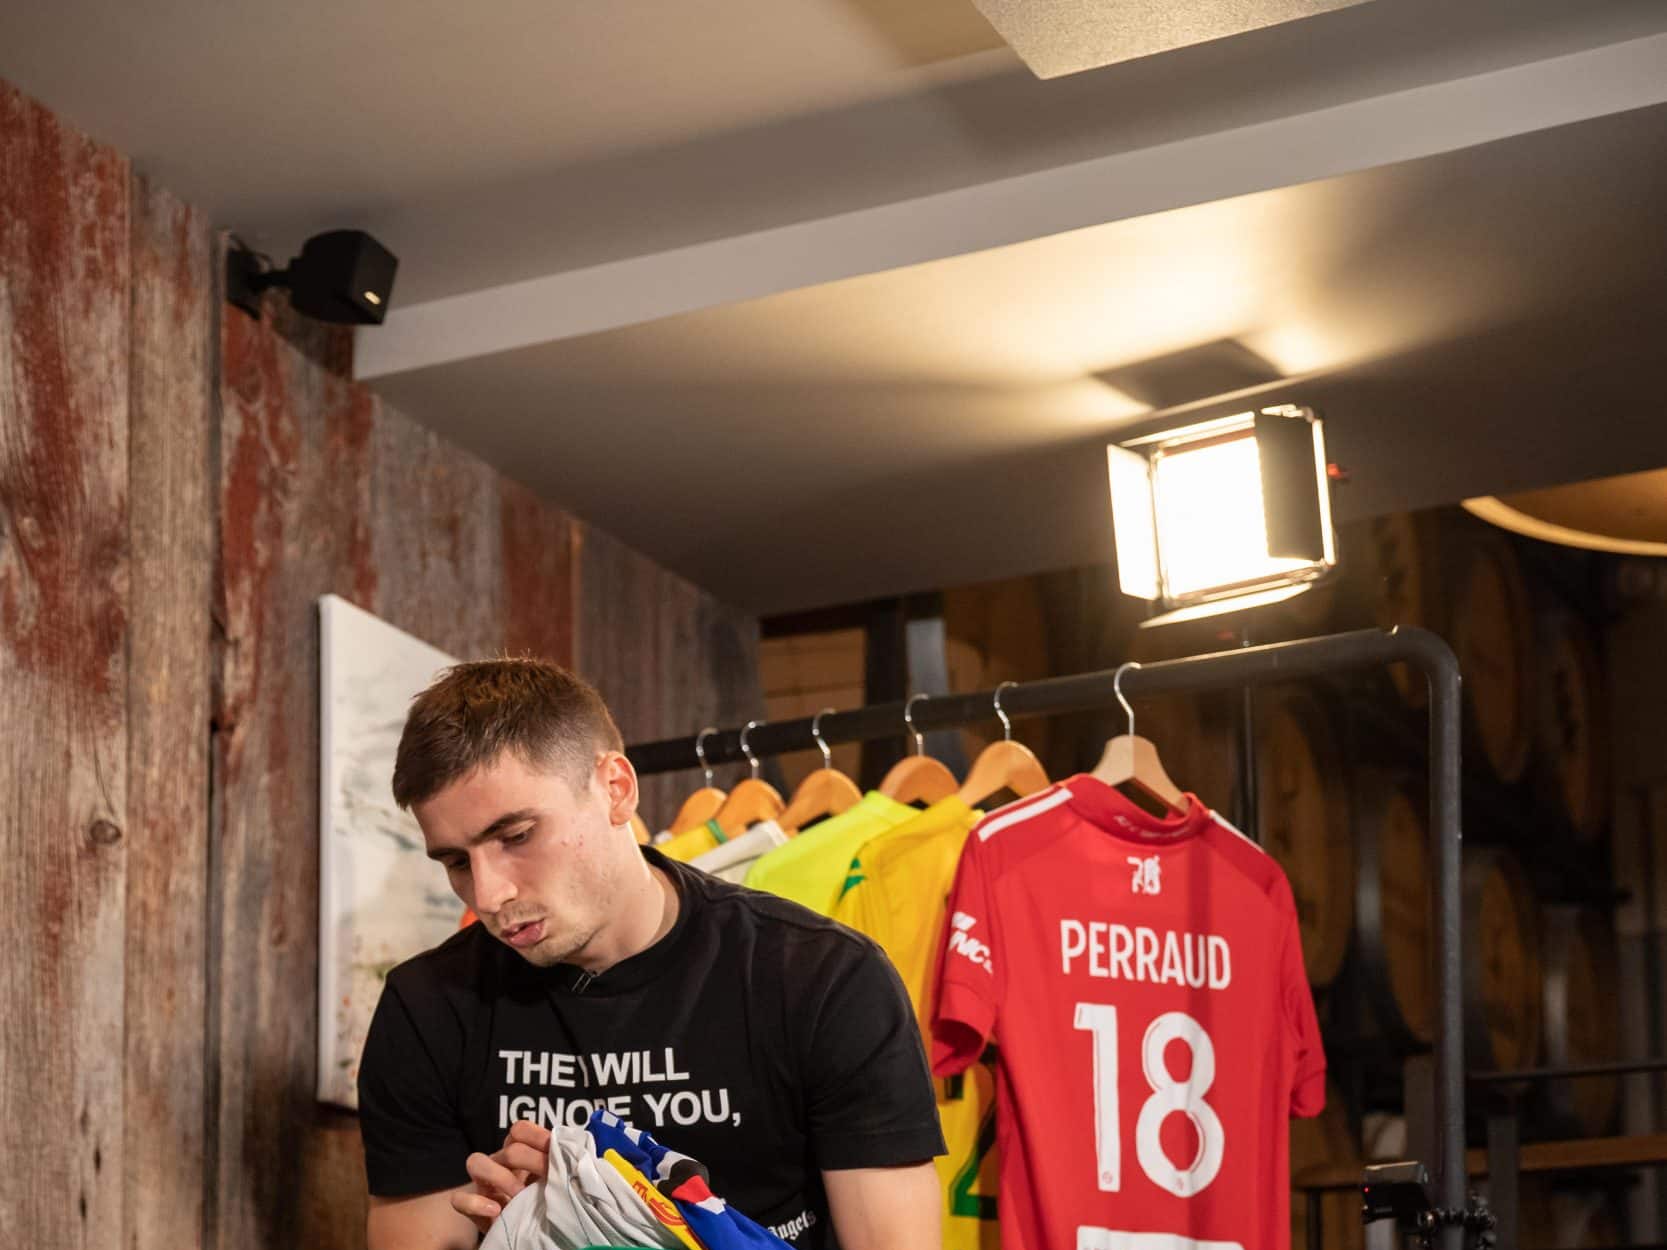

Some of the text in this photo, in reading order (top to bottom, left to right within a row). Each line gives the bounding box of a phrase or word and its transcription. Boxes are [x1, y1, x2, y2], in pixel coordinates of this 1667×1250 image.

[1060, 918, 1231, 990] PERRAUD
[591, 1047, 690, 1086] WILL
[499, 1088, 741, 1129] IGNOE YOU,
[1073, 1002, 1225, 1198] 18
